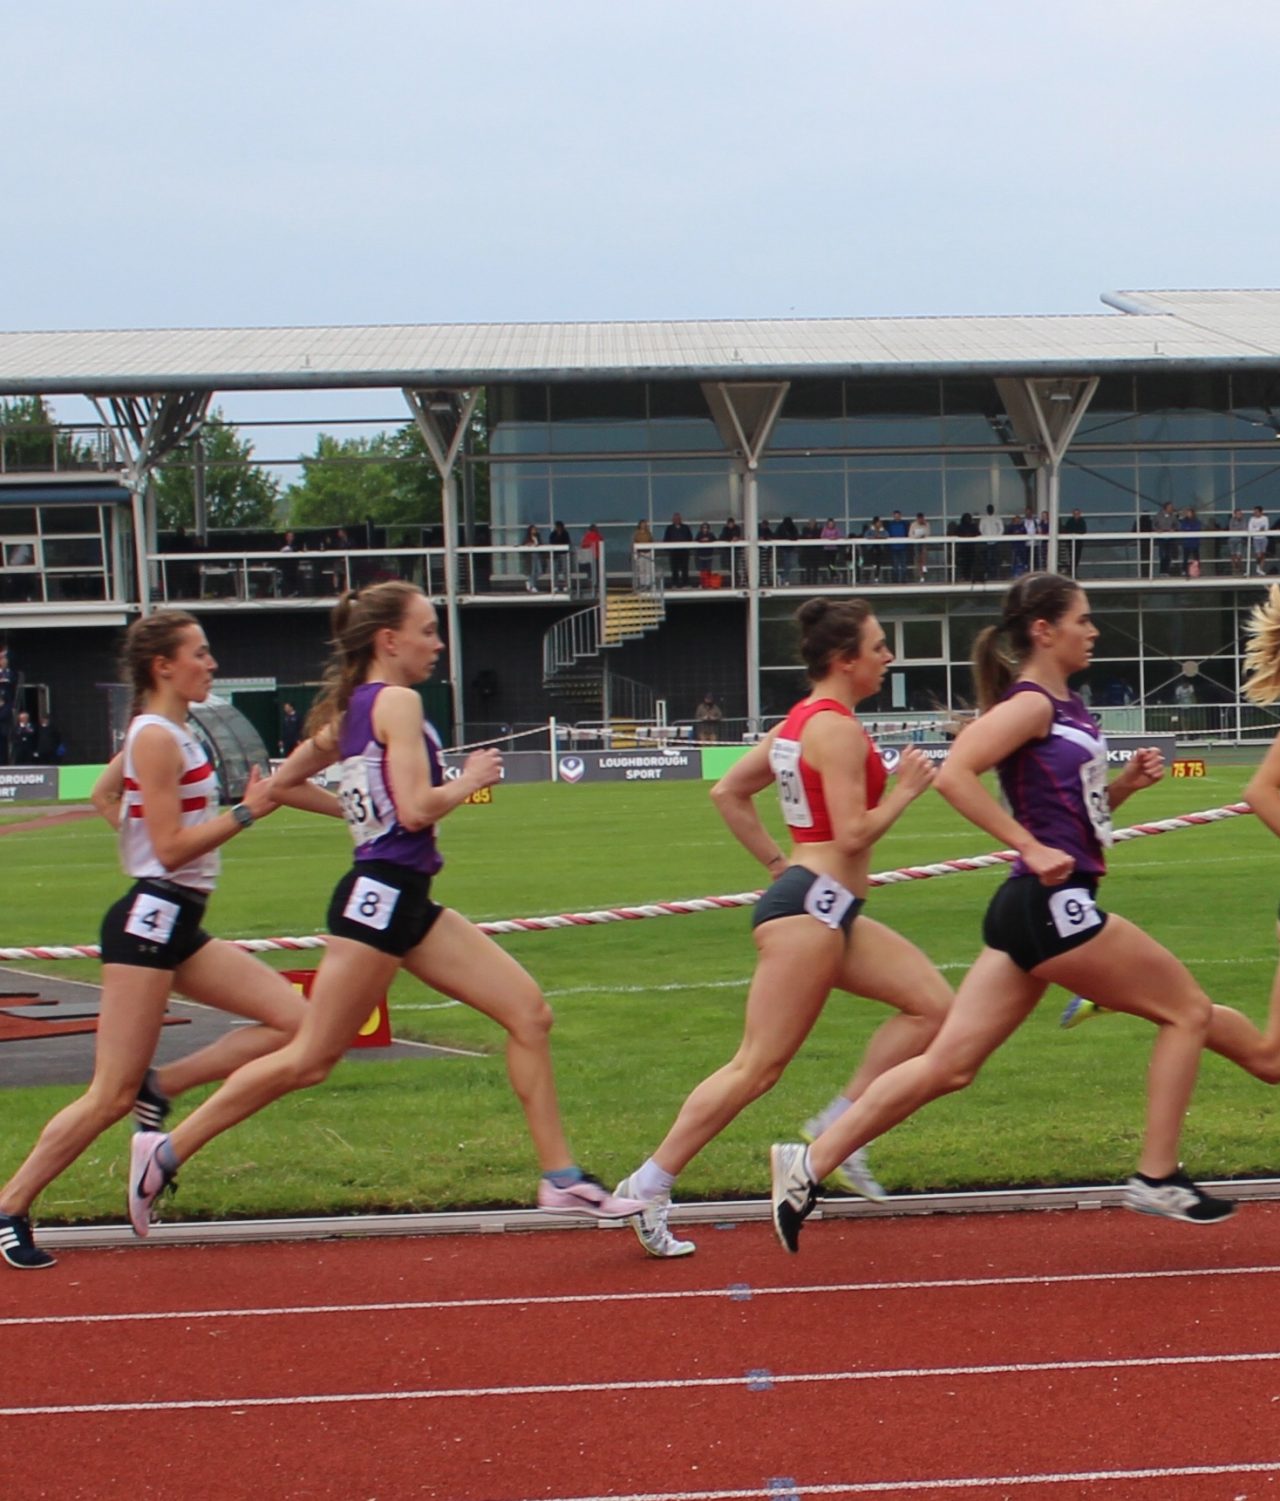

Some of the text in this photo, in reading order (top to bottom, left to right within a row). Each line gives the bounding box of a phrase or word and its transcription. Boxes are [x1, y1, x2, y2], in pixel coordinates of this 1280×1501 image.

[599, 756, 688, 768] LOUGHBOROUGH
[1173, 762, 1186, 777] 75
[1187, 762, 1204, 777] 75
[626, 769, 662, 779] SPORT
[359, 891, 379, 917] 8
[816, 889, 836, 914] 3
[142, 909, 160, 931] 4
[1065, 898, 1085, 925] 9
